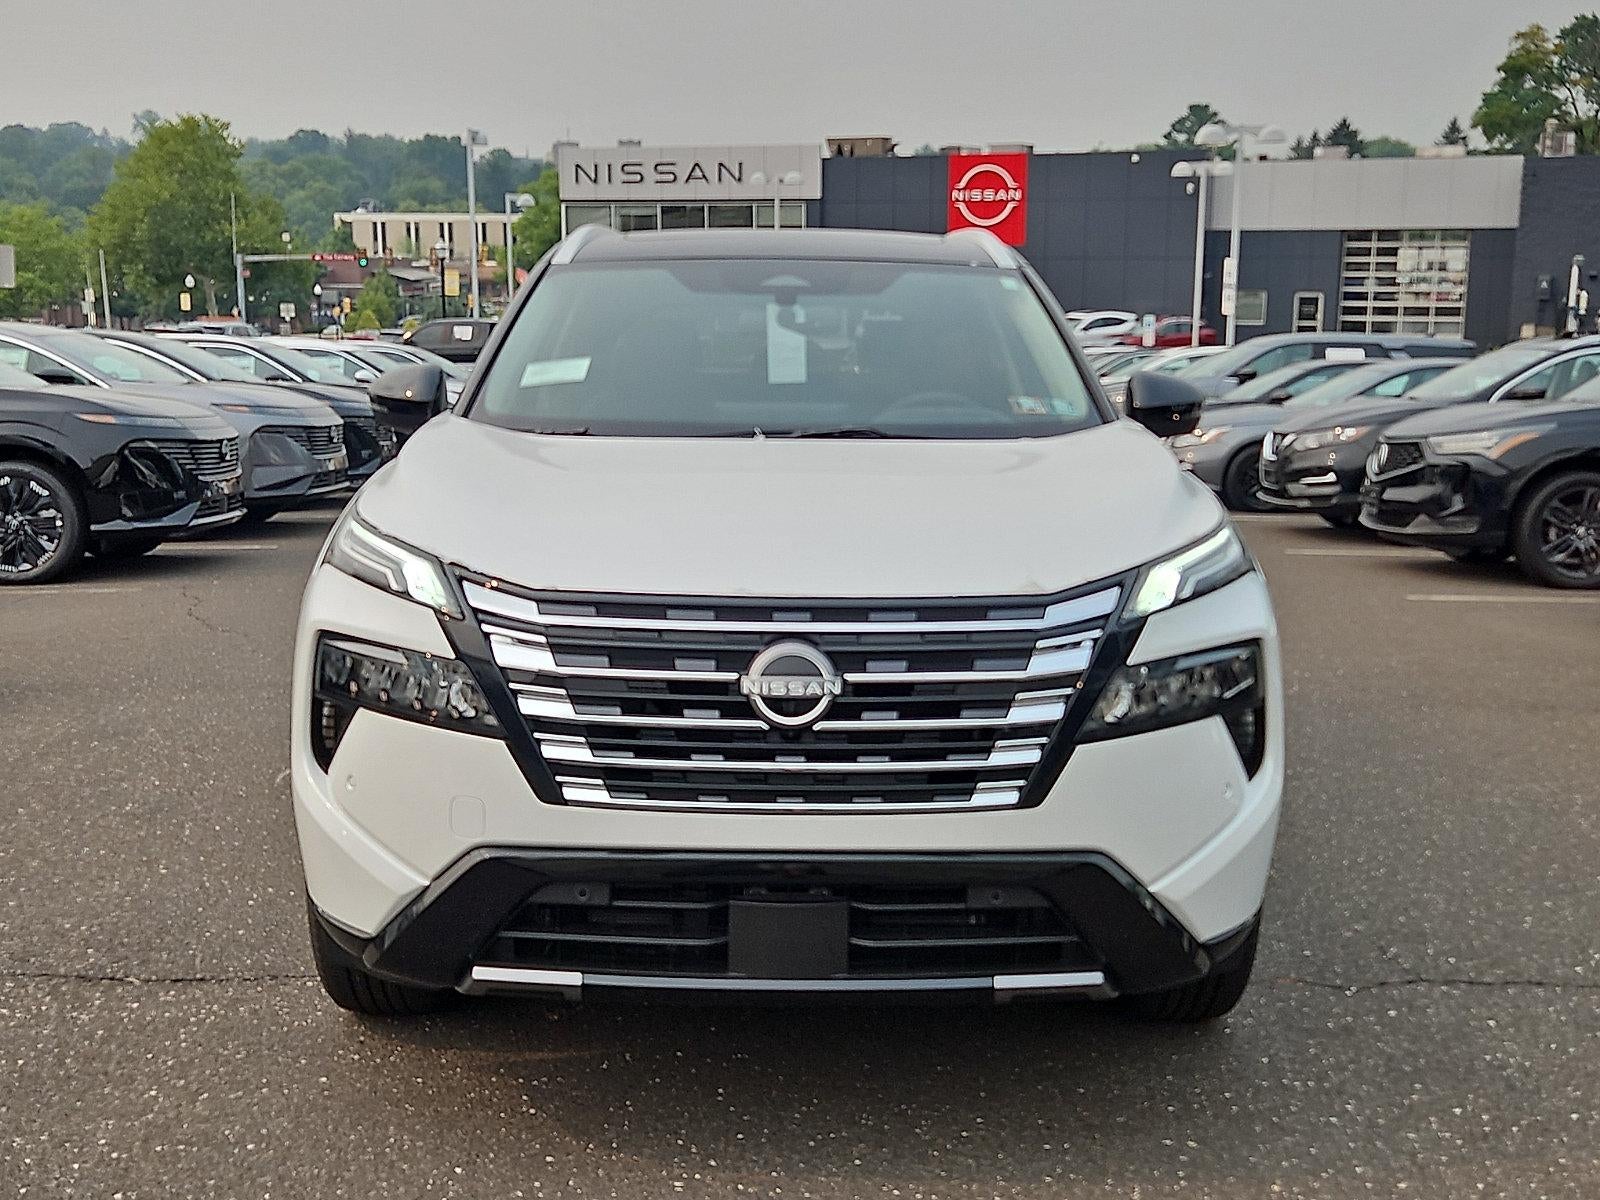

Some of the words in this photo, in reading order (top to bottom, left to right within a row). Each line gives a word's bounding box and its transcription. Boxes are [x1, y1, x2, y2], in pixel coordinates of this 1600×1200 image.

[574, 162, 743, 184] NISSAN
[952, 188, 1022, 202] NISSAN
[742, 680, 842, 696] NISSAN
